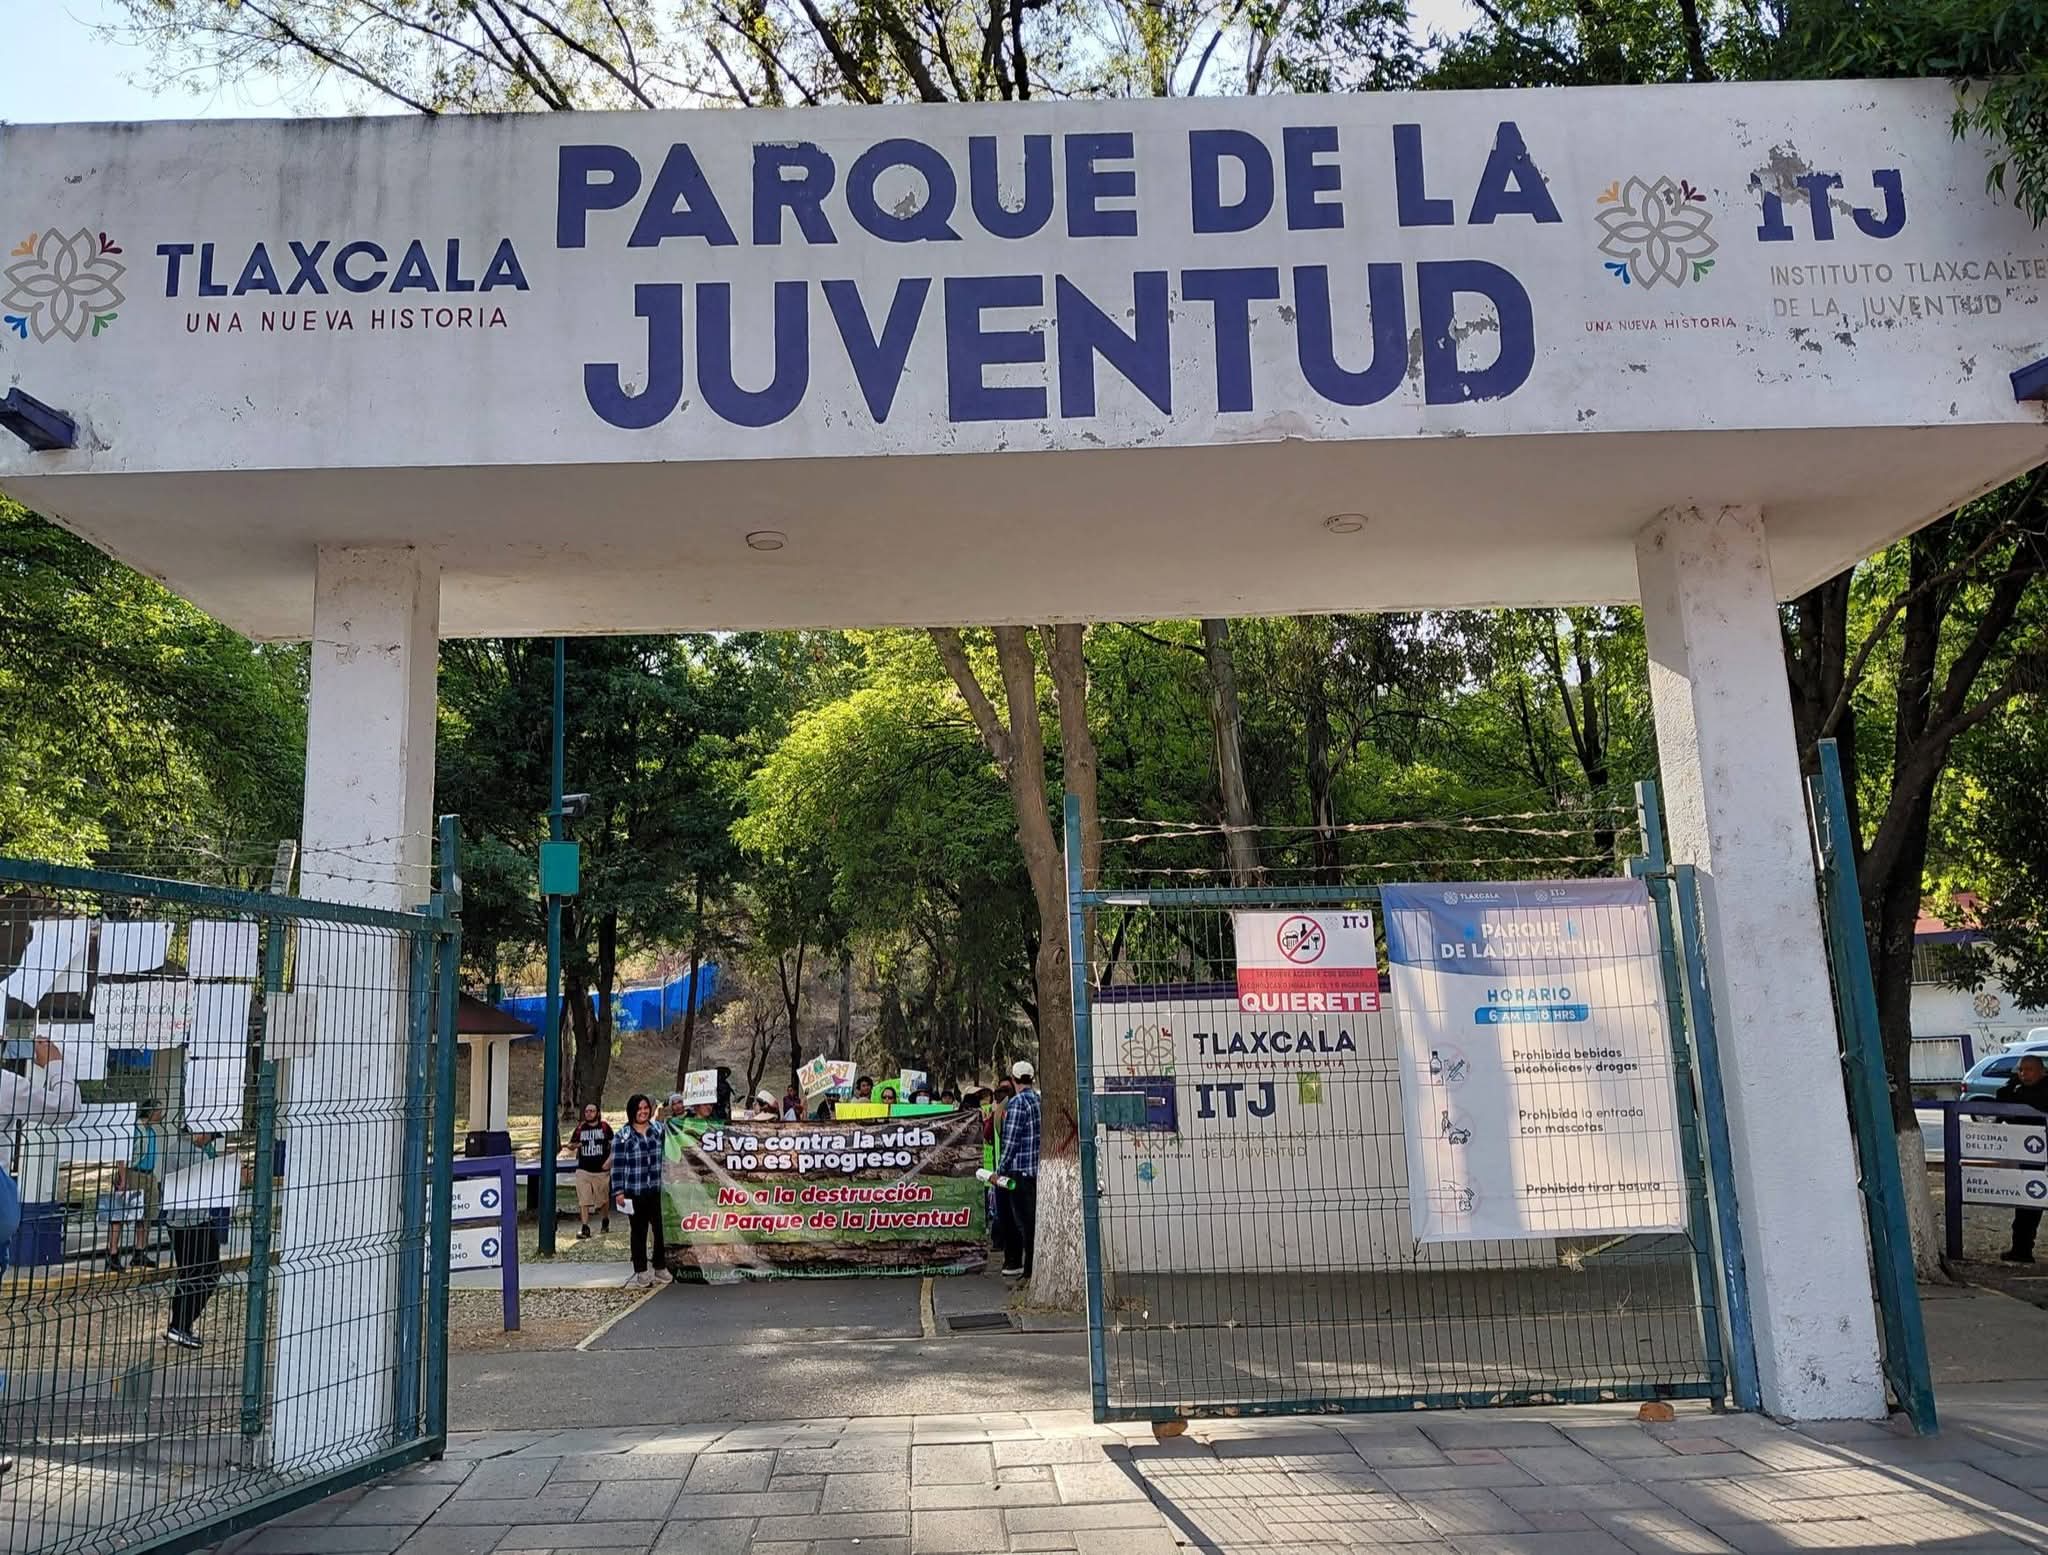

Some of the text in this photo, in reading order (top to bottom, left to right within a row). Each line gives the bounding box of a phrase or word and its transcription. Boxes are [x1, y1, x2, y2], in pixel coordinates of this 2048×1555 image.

[556, 121, 1564, 249] PARQUE DE LA
[1749, 168, 1908, 243] ITJ
[156, 237, 531, 298] TLAXCALA
[1770, 258, 2048, 287] INSTITUTO TLAXCALTE
[1773, 295, 2003, 326] DE LA JUVENTUD
[186, 307, 508, 334] UNA NUEVA HISTORIA
[1585, 317, 1737, 332] UNA NUEVA HISTORIA
[583, 260, 1536, 430] JUVENTUD
[1342, 916, 1369, 928] ITJ
[1481, 922, 1561, 939] PARQUE
[1441, 943, 1466, 958] DE
[1472, 943, 1497, 958] LA
[1241, 992, 1377, 1011] QUIERETE
[1487, 987, 1571, 1002] HORARIO
[1488, 1009, 1498, 1022] 6
[1502, 1011, 1520, 1021] AM
[1553, 1009, 1576, 1020] HRS
[1193, 1030, 1356, 1054] TLAXCALA
[1513, 1047, 1622, 1060] Prohibida bebidas
[1206, 1059, 1345, 1070] UNA NUEVA HISTORIA
[1586, 1065, 1592, 1075] y
[1595, 1061, 1639, 1074] drogas
[1195, 1081, 1276, 1119] ITJ
[1519, 1106, 1643, 1120] Prohibida la entrada
[1545, 1122, 1603, 1133] mascotas
[702, 1127, 936, 1150] Si va contra la vida
[1965, 1133, 2008, 1142] OFICINAS
[1201, 1145, 1307, 1160] DE LA JUVENTUD
[727, 1150, 912, 1174] no es progreso
[718, 1182, 933, 1206] No a la destrucción
[1526, 1180, 1660, 1195] Prohibida tirar basura
[1966, 1186, 2021, 1197] RECREATIVA
[682, 1207, 970, 1232] del Parque de la juventud
